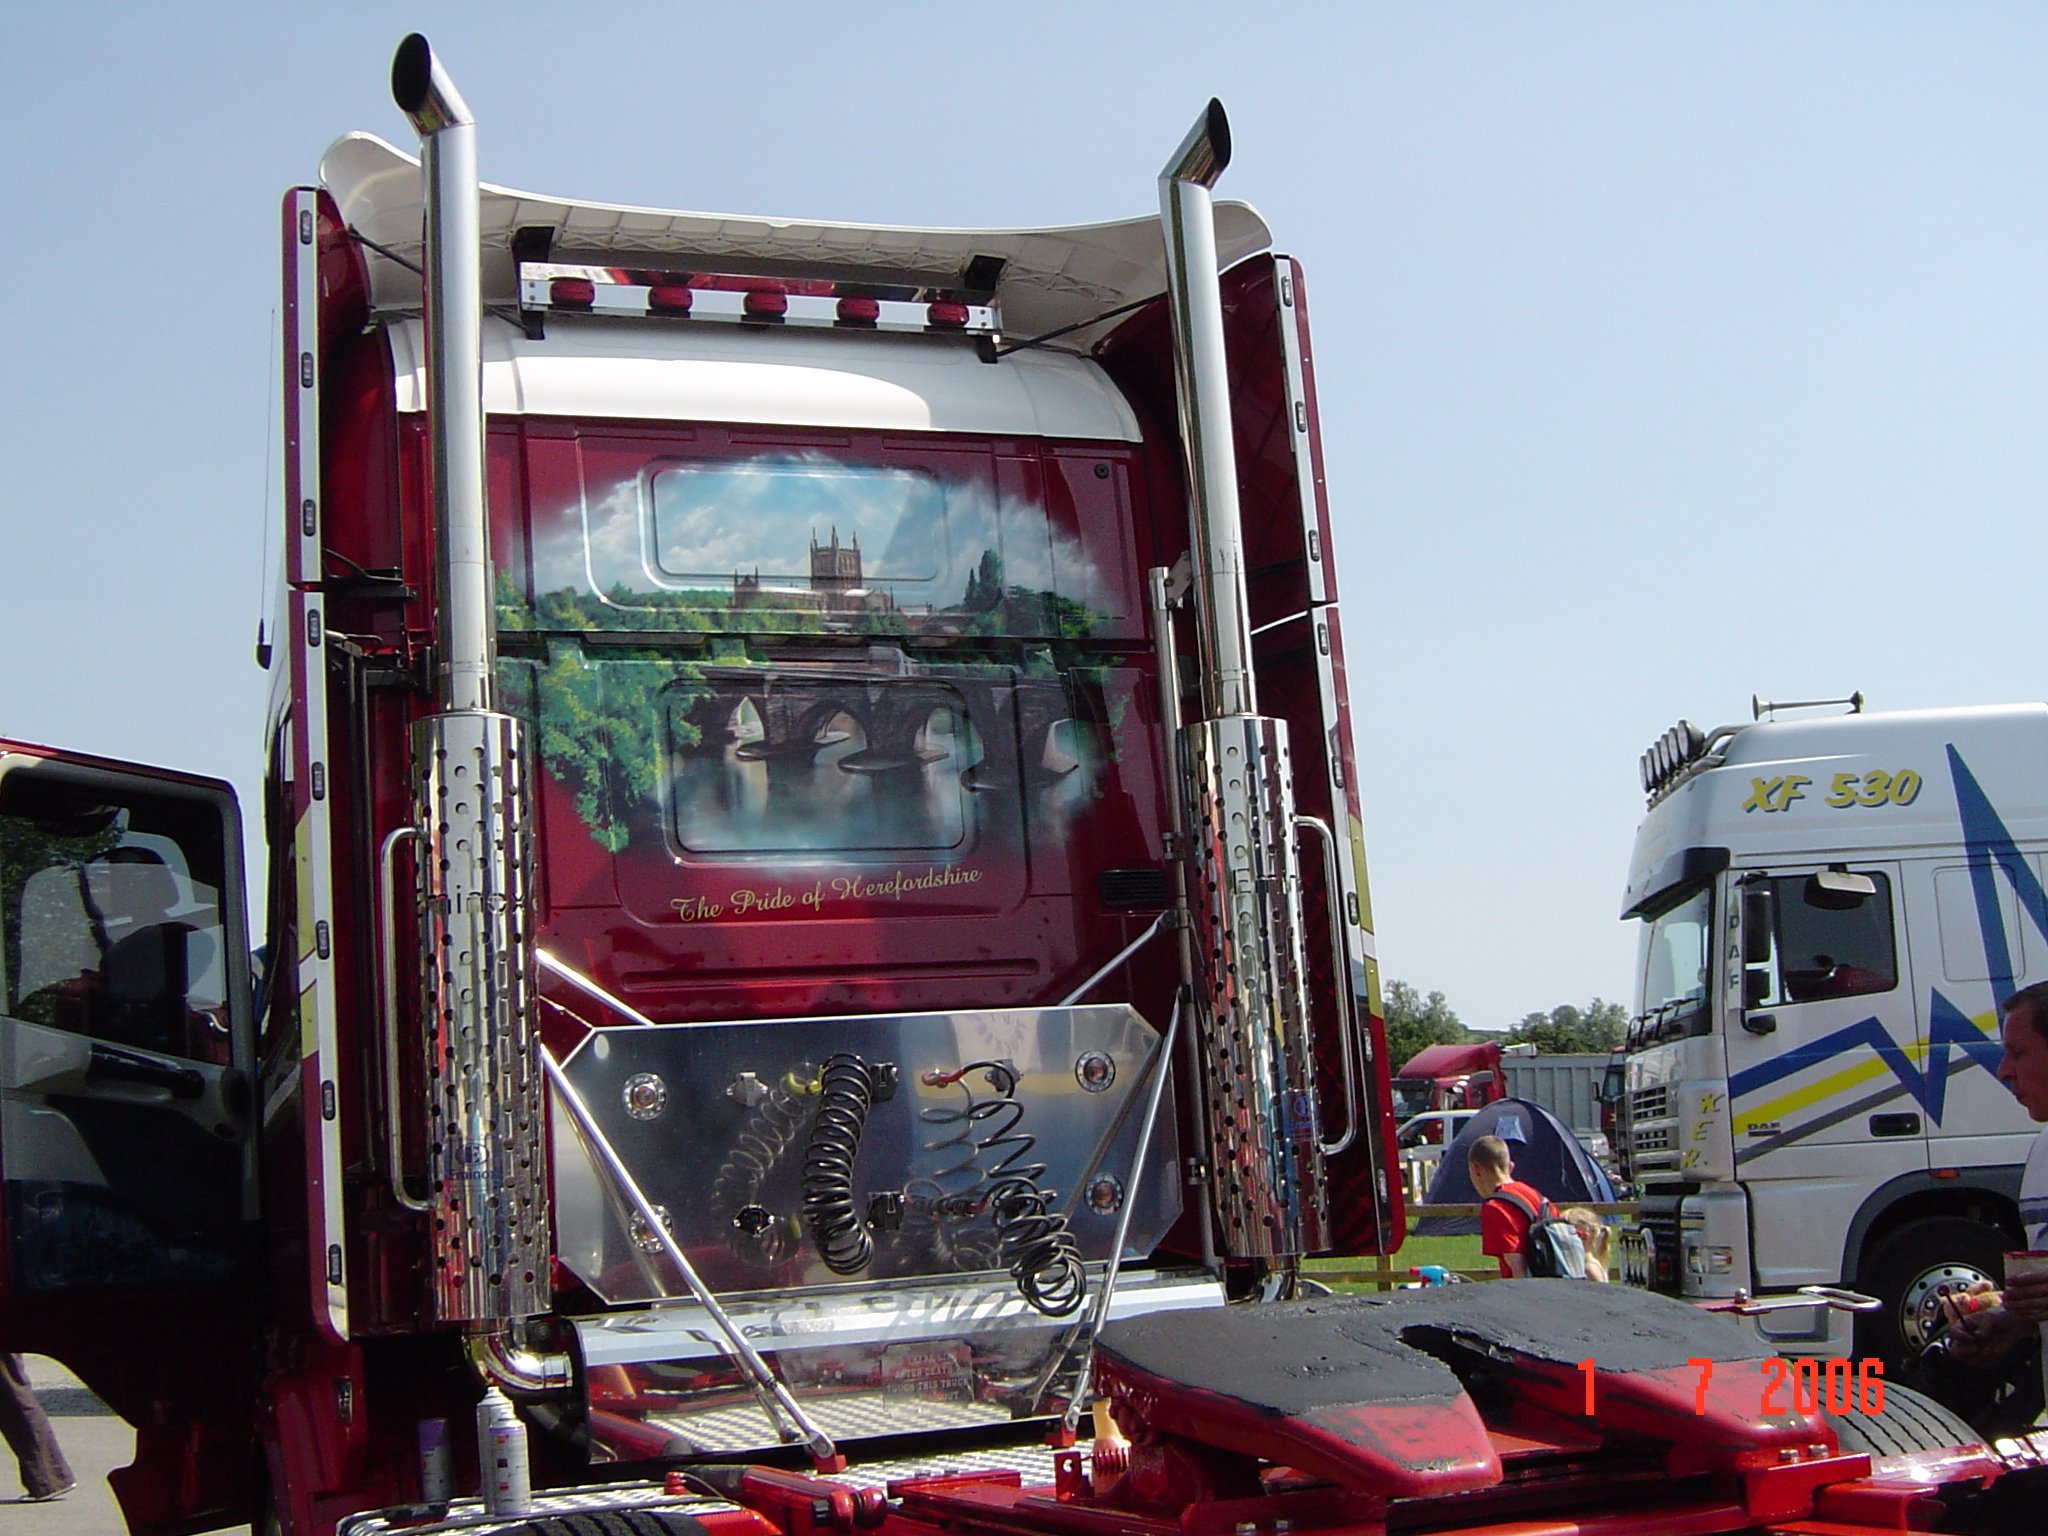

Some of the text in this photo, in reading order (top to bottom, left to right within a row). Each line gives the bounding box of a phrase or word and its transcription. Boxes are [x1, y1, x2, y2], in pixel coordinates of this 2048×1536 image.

[1742, 768, 1923, 813] XF 530
[670, 863, 983, 922] The Pride of Herefordshire
[1747, 1121, 1781, 1131] DAF
